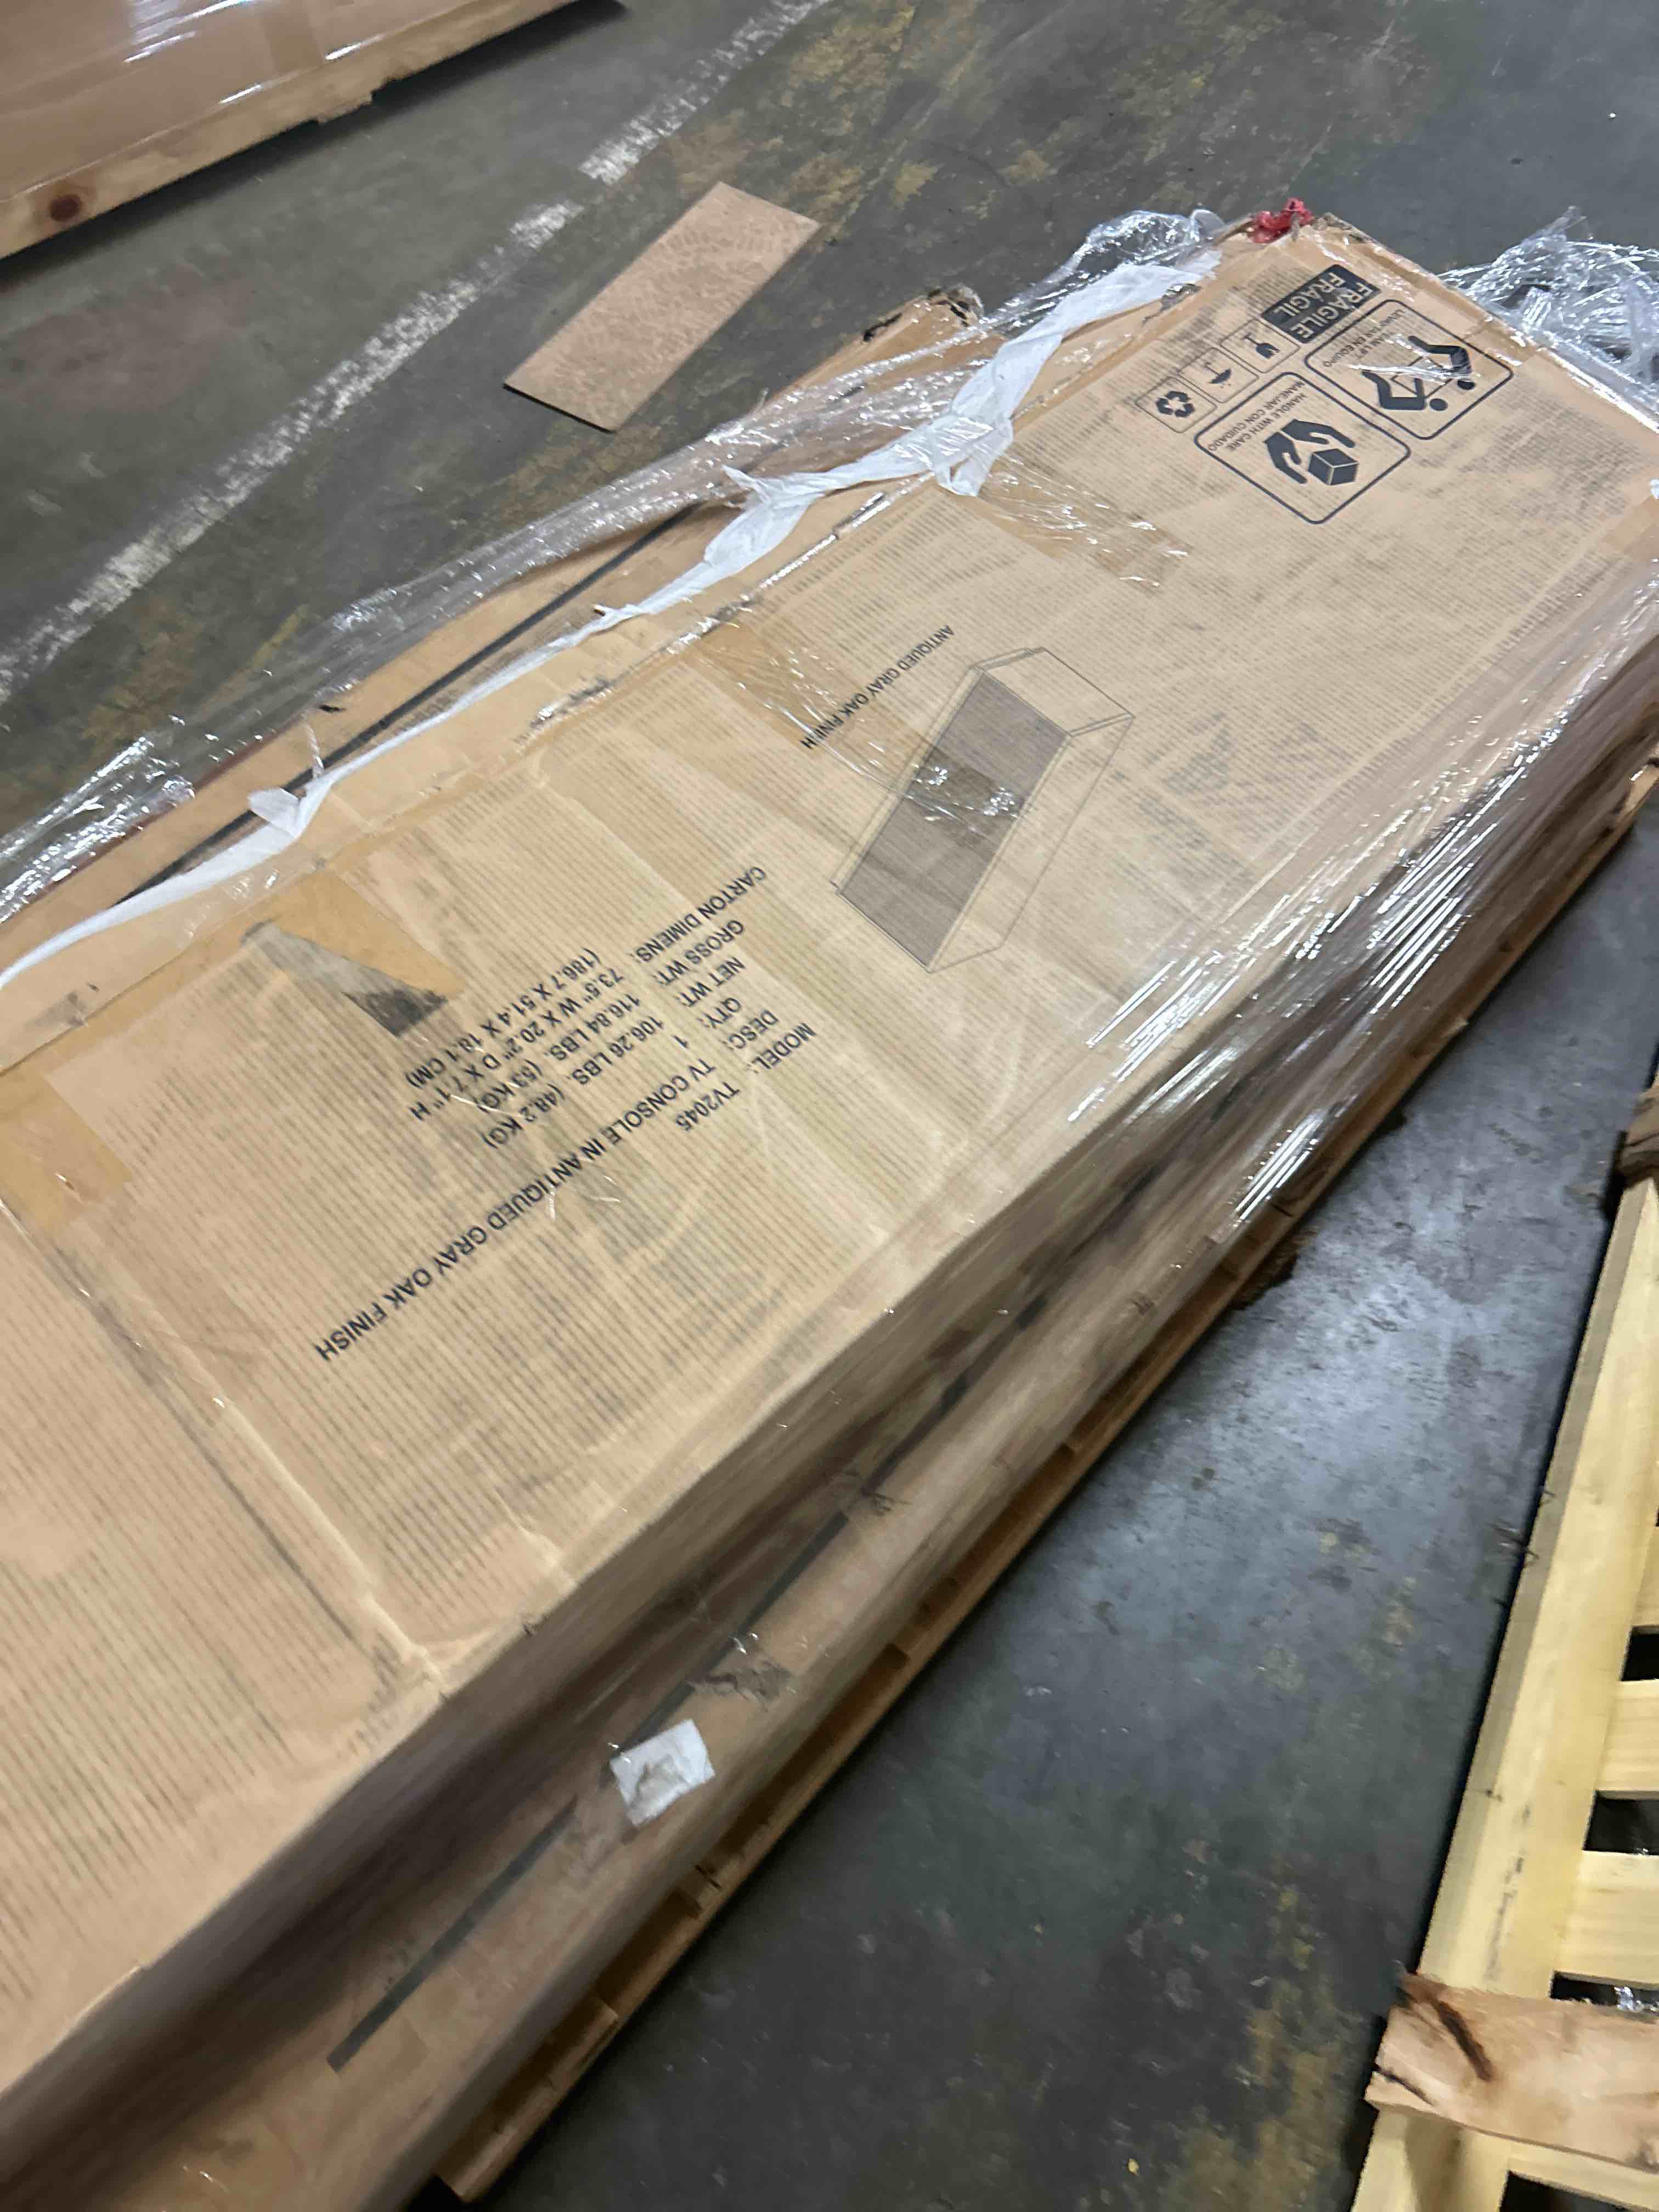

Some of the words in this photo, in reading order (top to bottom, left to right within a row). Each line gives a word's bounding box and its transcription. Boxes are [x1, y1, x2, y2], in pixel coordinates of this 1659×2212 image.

[1289, 283, 1373, 339] FRAGILE
[1322, 345, 1355, 368] EQUIPO
[1351, 336, 1367, 347] EN
[1263, 380, 1305, 410] MANEJAR
[1271, 393, 1307, 419] HANDLE
[1244, 408, 1265, 424] CON
[1249, 416, 1274, 435] WITH
[1207, 421, 1246, 452] CUIDADO
[1226, 432, 1251, 451] CARE
[895, 623, 955, 672] ANTIQUED
[865, 665, 900, 697] GRAY
[838, 692, 868, 716] OAK
[696, 866, 766, 921] CARTON
[628, 912, 701, 964] DIMENS:
[682, 918, 745, 965] GROSS
[549, 947, 601, 991] (186.7
[652, 957, 689, 986] WT:
[708, 956, 746, 988] NET
[531, 982, 552, 1002] X
[557, 995, 582, 1019] W
[675, 980, 712, 1008] WT:
[495, 993, 536, 1028] 51.4
[540, 1008, 562, 1029] X
[584, 991, 640, 1035] 116.84
[697, 996, 743, 1031] QTY:
[479, 1018, 500, 1040] X
[544, 1027, 590, 1063] LBS.
[607, 1014, 663, 1058] 106.26
[671, 1034, 688, 1050] 1
[720, 1009, 780, 1053] DESC:
[480, 1052, 500, 1072] D
[746, 1022, 816, 1075] MODEL:
[404, 1056, 446, 1091] CM)
[462, 1063, 483, 1083] X
[509, 1058, 542, 1091] (53
[565, 1051, 613, 1087] LBS.
[687, 1058, 716, 1081] TV
[409, 1102, 431, 1122] H
[474, 1082, 514, 1115] KG)
[517, 1084, 564, 1123] (48.2
[599, 1073, 690, 1145] CONSOLE
[673, 1080, 740, 1132] TV2045
[478, 1115, 523, 1150] KG)
[580, 1137, 606, 1161] IN
[485, 1152, 582, 1230] ANTIQUED
[431, 1224, 489, 1274] GRAY
[381, 1266, 433, 1309] OAK
[314, 1302, 387, 1362] FINISH
